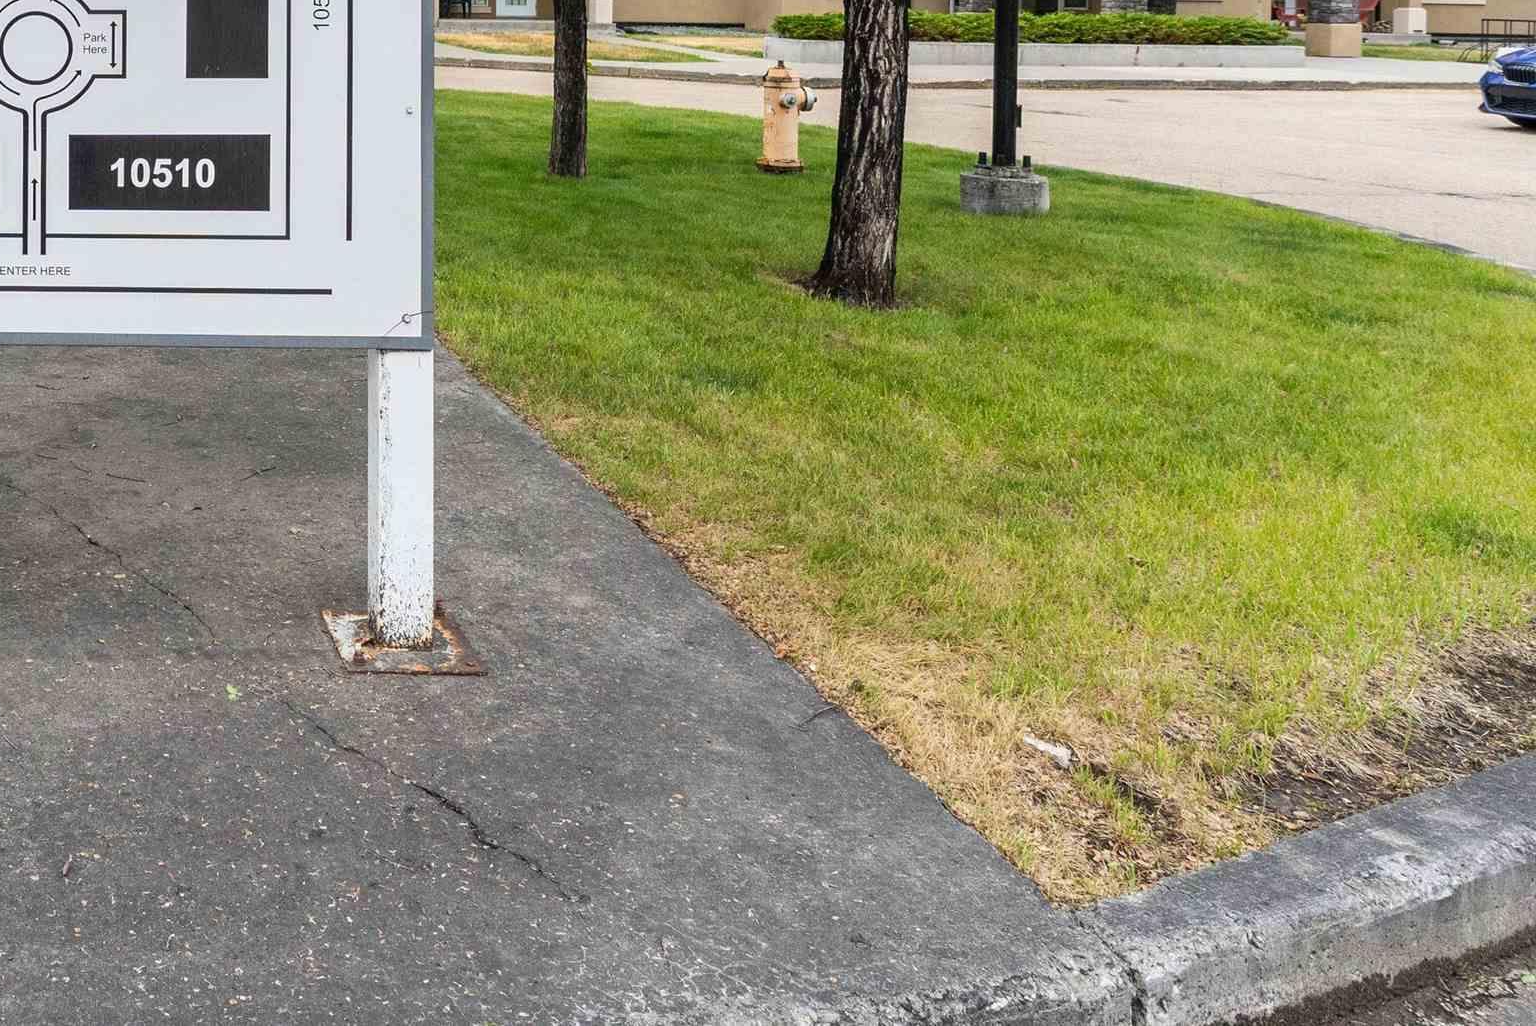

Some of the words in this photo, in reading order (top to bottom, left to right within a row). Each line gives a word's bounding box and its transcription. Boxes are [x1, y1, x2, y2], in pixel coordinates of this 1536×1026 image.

[83, 32, 107, 43] Park
[82, 44, 108, 55] Here
[109, 157, 217, 189] 10510
[0, 265, 38, 276] ENTER
[40, 266, 71, 276] HERE
